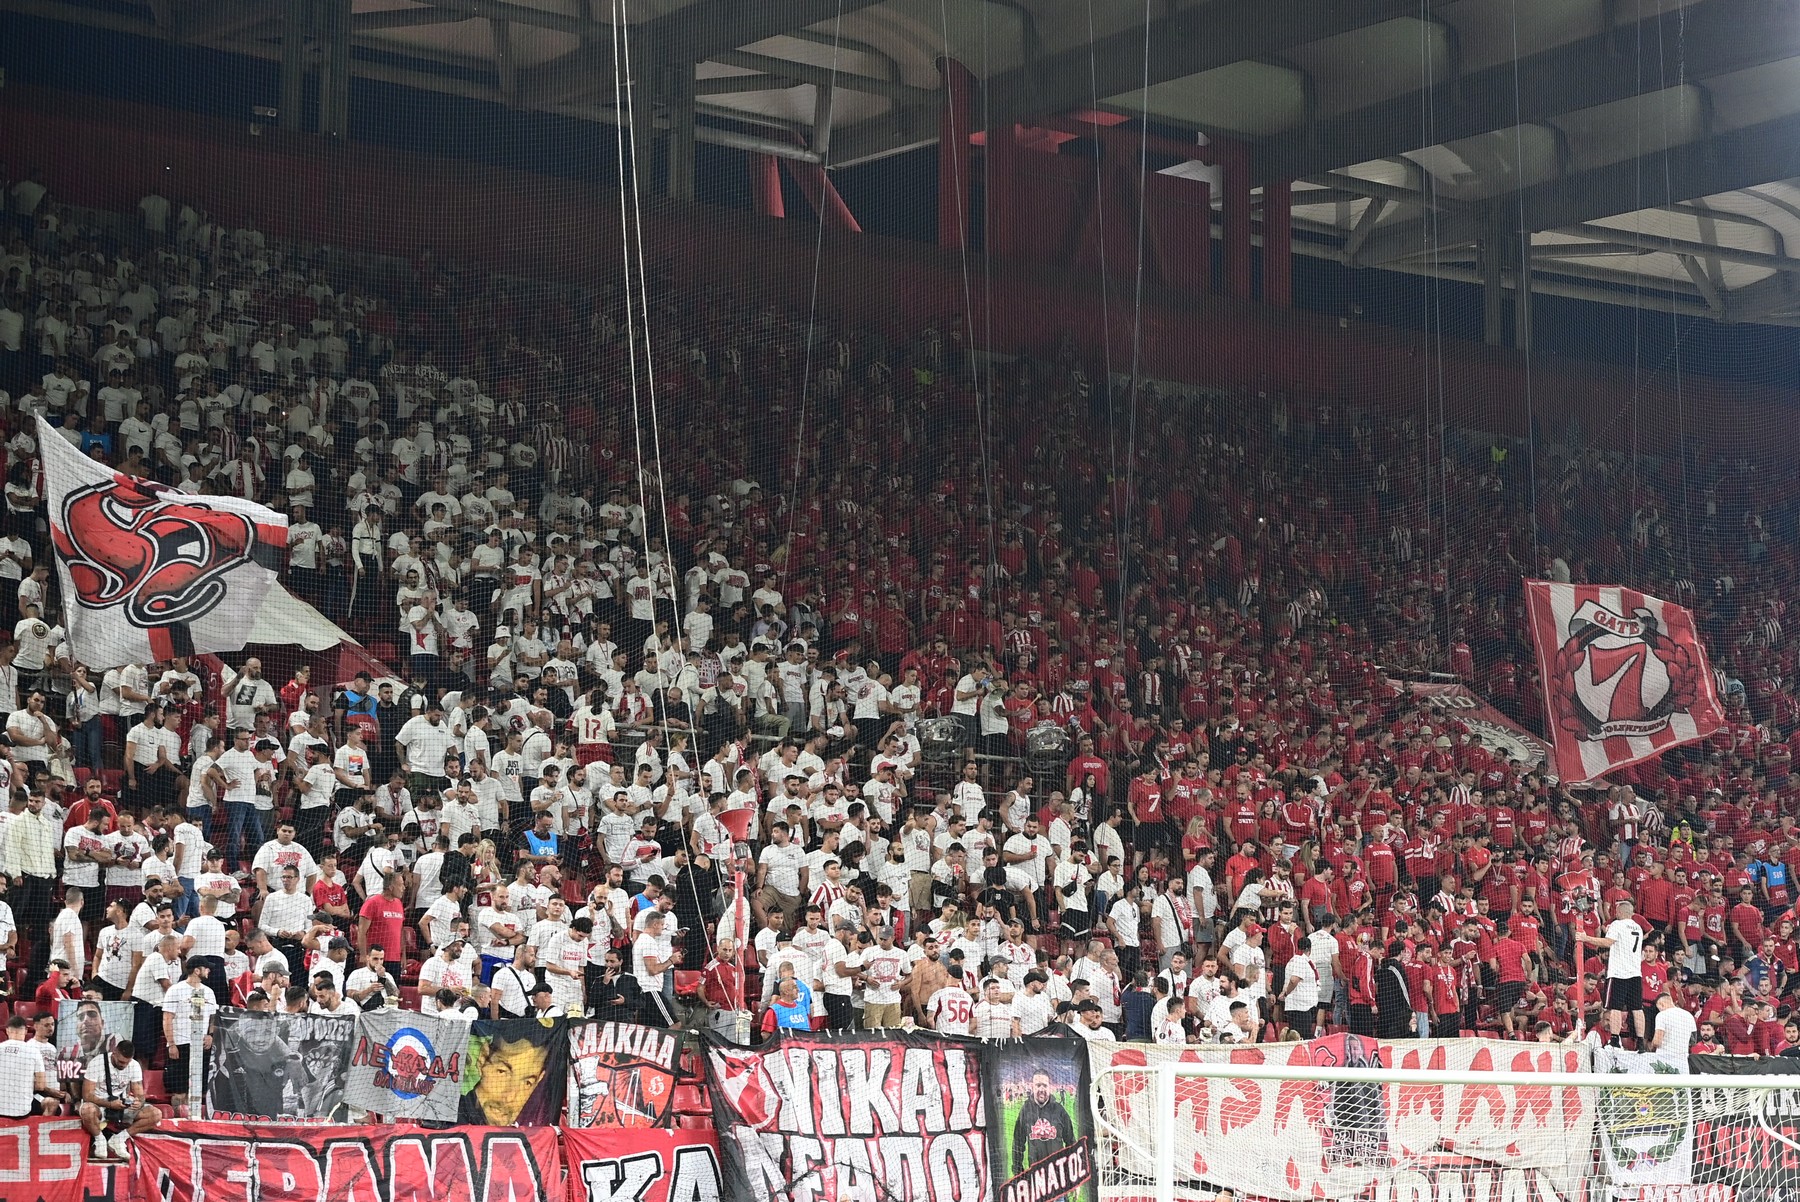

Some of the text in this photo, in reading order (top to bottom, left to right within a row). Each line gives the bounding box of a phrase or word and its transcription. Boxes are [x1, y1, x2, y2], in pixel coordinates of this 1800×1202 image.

[1593, 610, 1640, 635] GATE
[1588, 641, 1647, 721] 7
[584, 717, 601, 740] 17
[505, 767, 514, 775] DO
[507, 760, 519, 768] JUST
[1148, 794, 1161, 813] 7
[1630, 931, 1640, 953] 7
[947, 999, 969, 1024] 56
[762, 1046, 987, 1136] ΝΙΚΑΙ
[734, 1124, 994, 1202] ΝΕΑΠΟ
